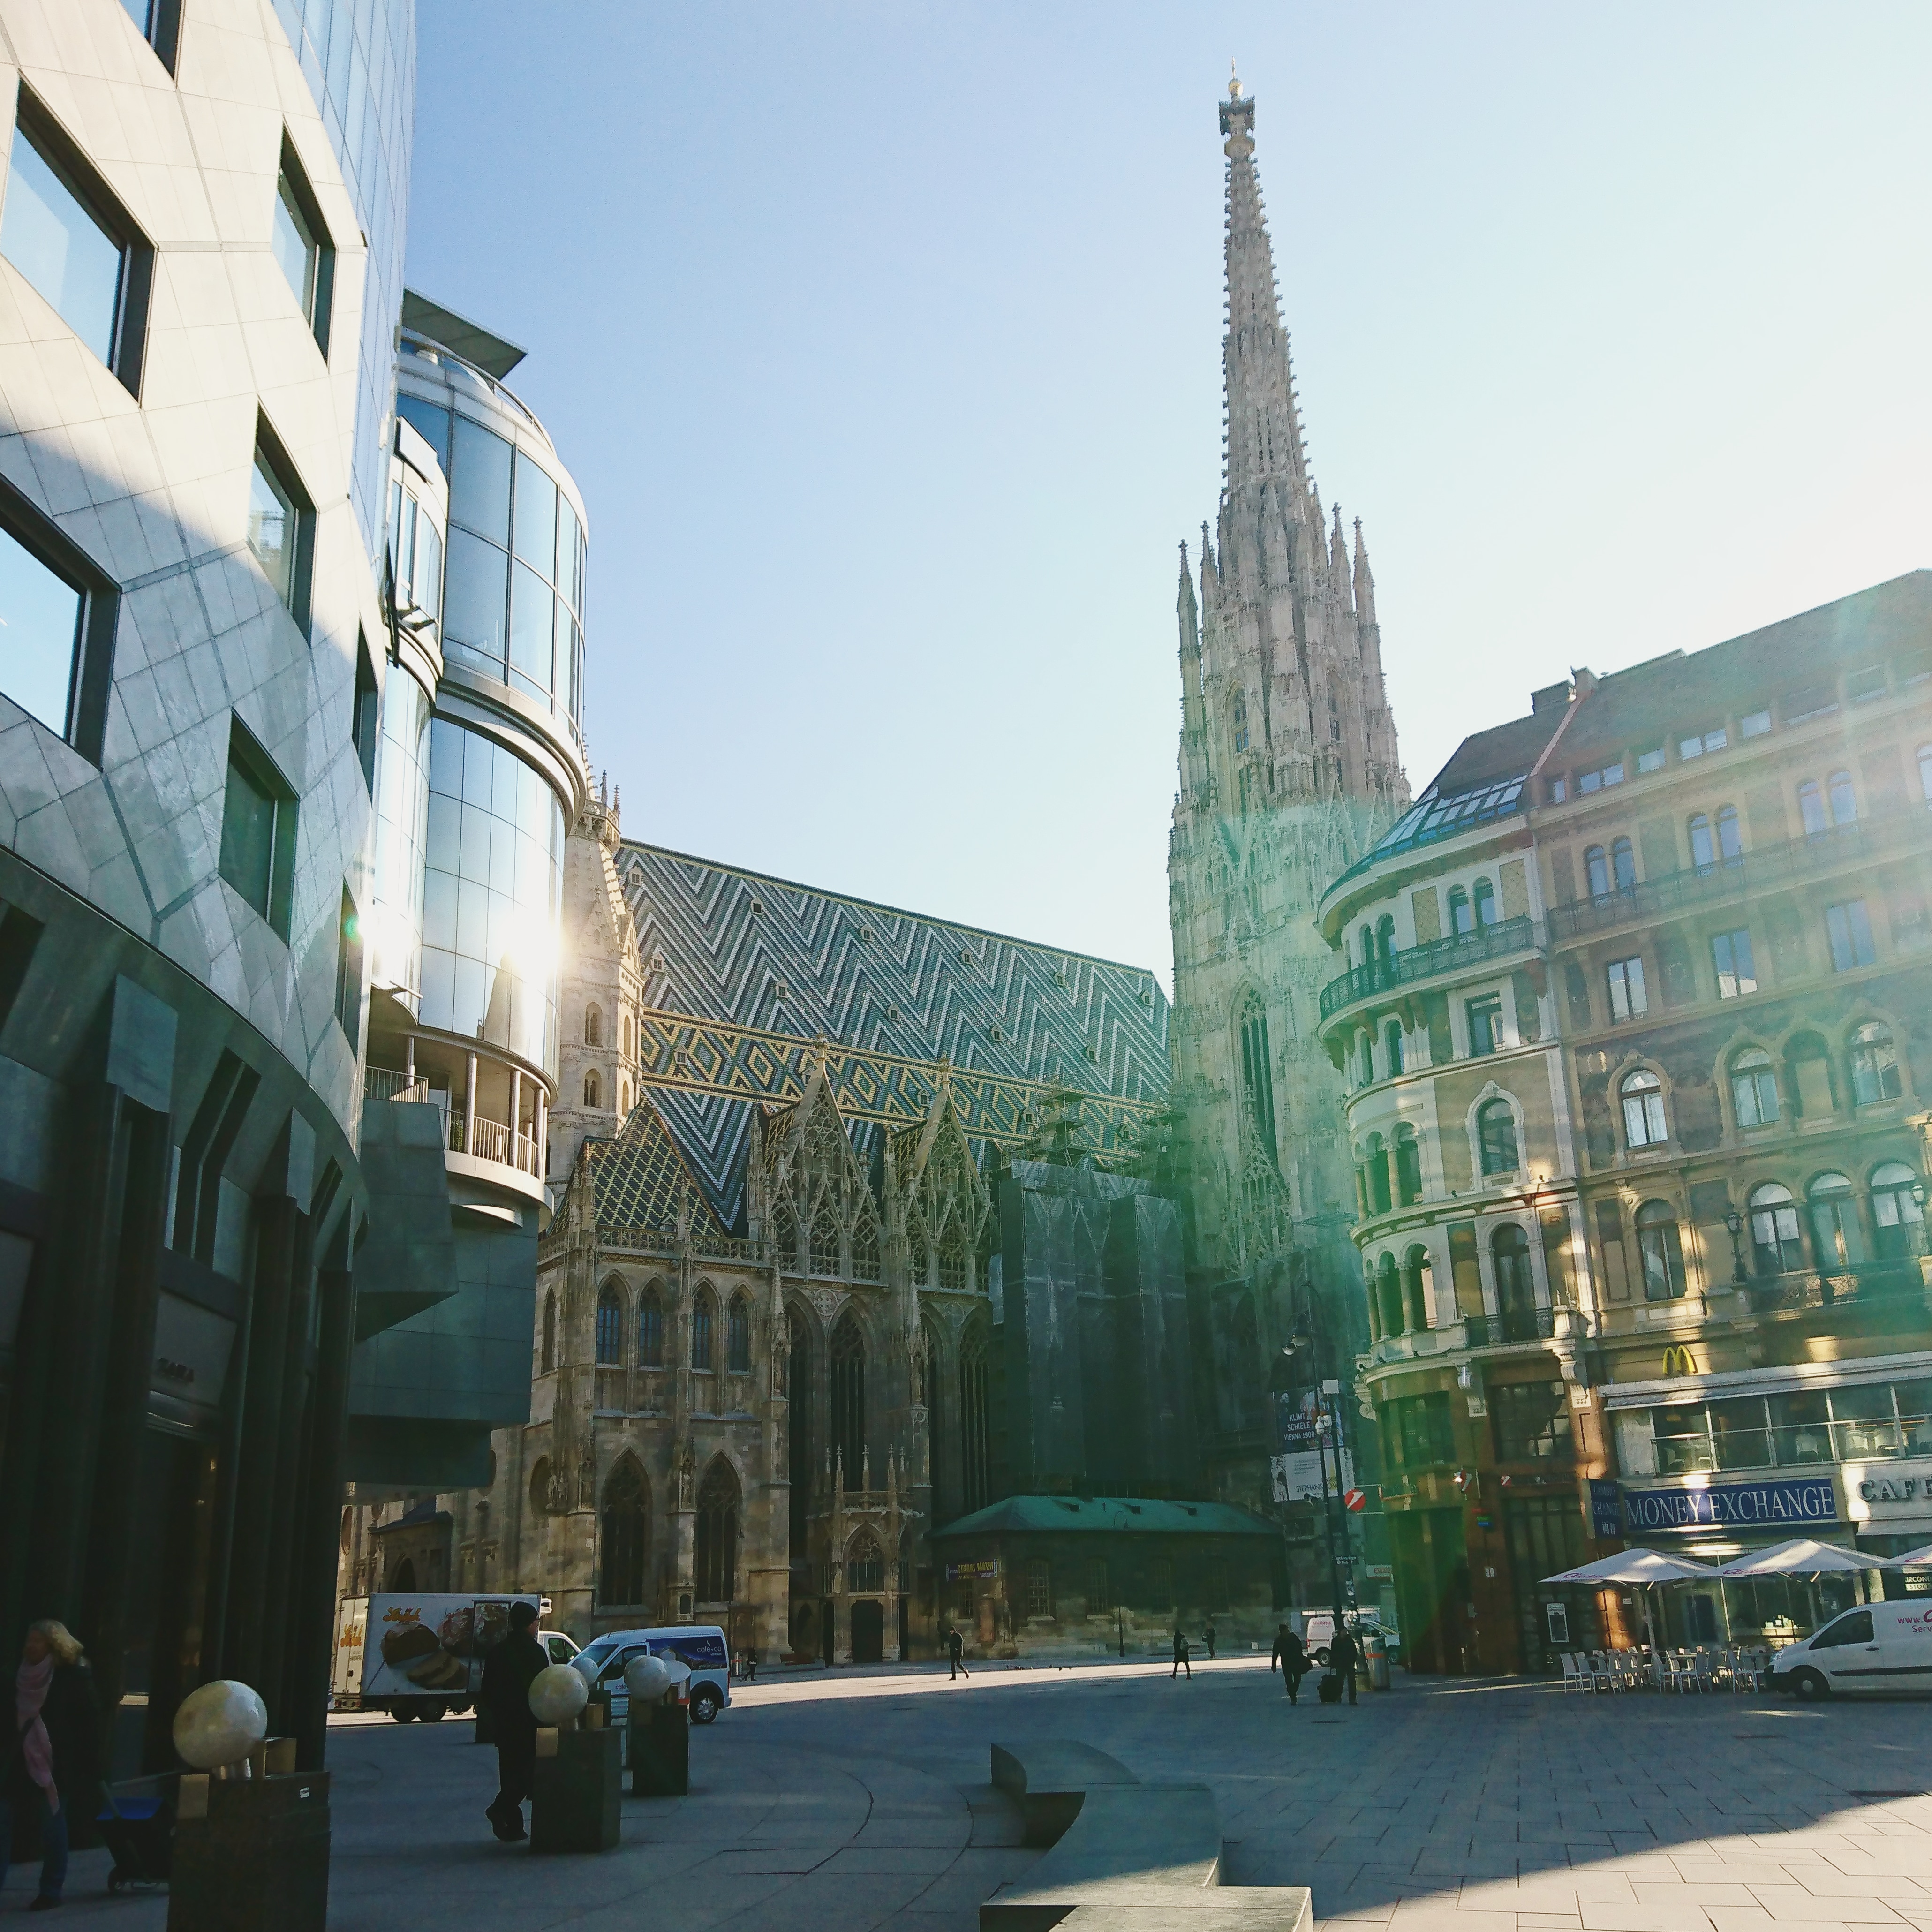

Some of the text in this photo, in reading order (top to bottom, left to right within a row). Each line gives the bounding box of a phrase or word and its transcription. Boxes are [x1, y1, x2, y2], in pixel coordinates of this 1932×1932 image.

[1289, 1412, 1305, 1421] KLIMT
[1287, 1421, 1311, 1431] SCHIELE
[1593, 1502, 1620, 1516] CHANGE
[1624, 1487, 1835, 1525] MONEY EXCHANGE
